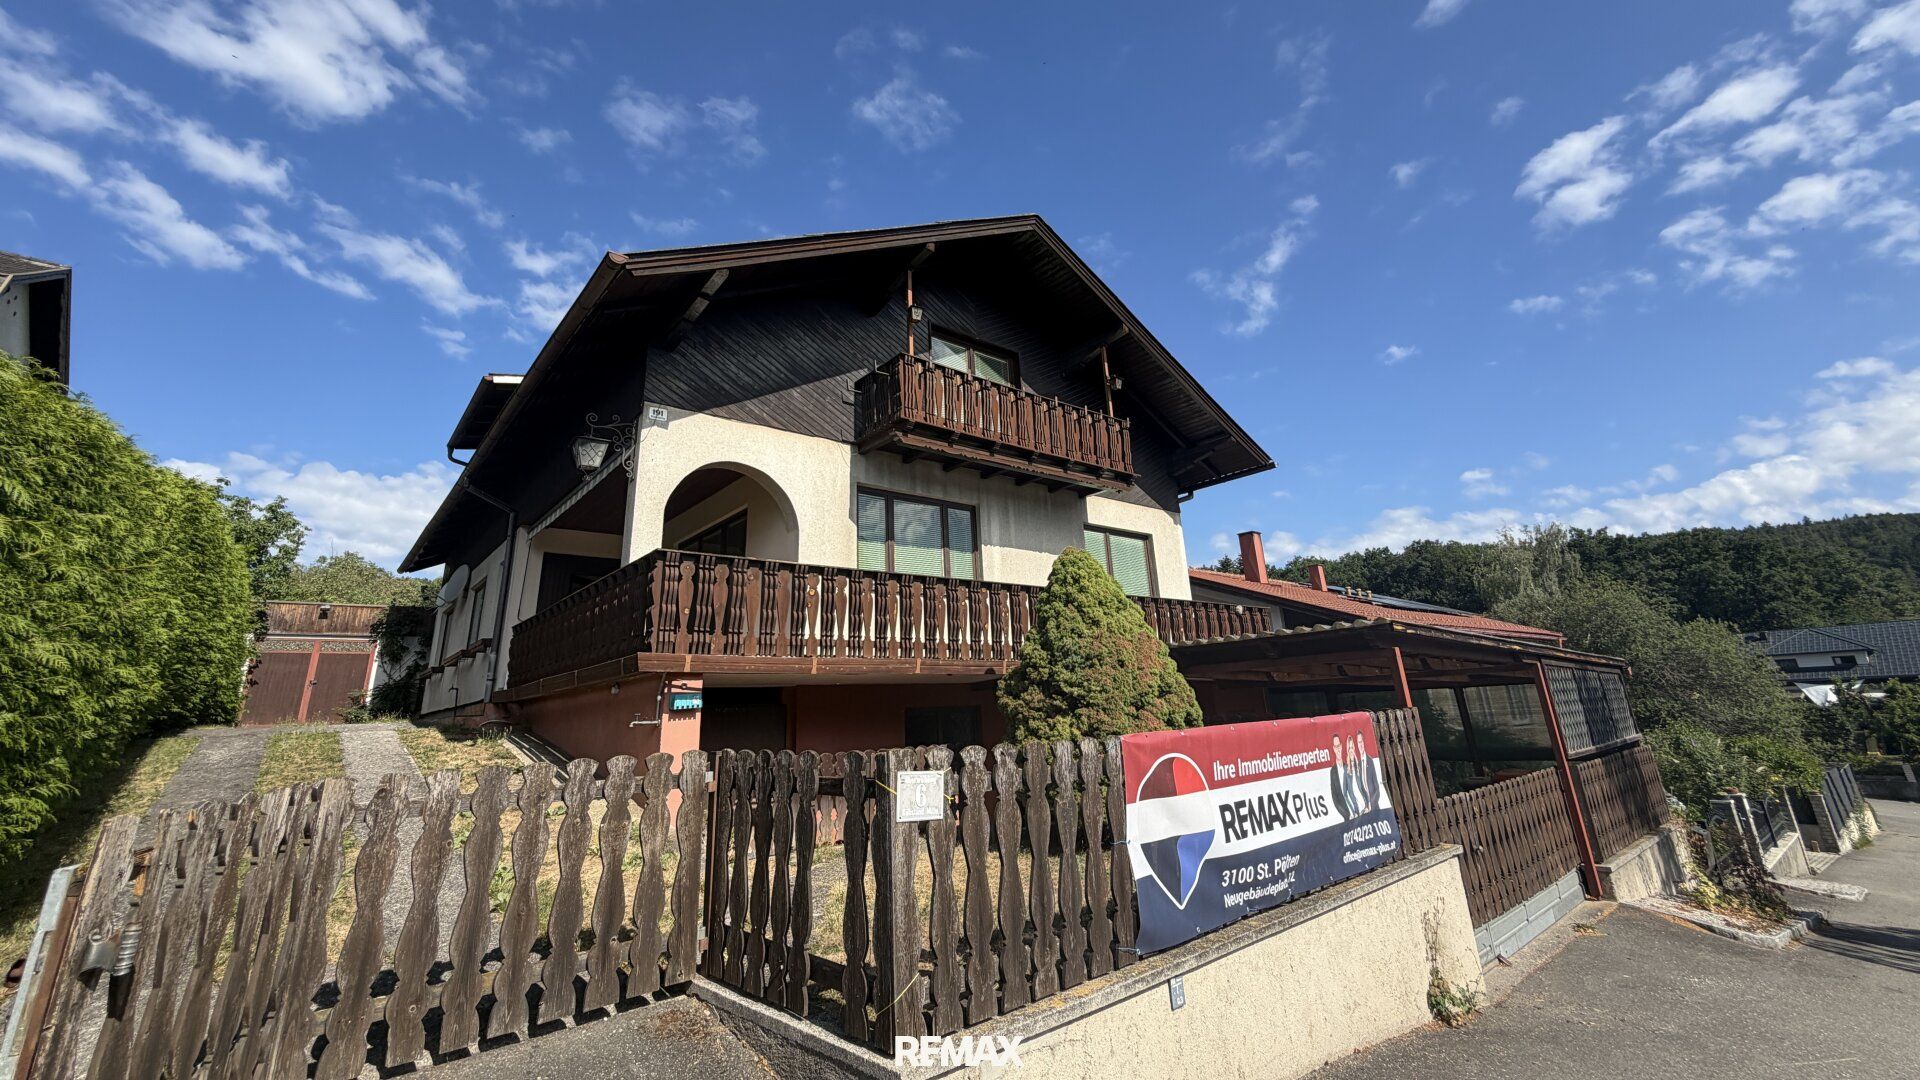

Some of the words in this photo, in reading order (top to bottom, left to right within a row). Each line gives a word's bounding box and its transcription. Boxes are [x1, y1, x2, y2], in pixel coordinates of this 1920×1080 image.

[1213, 759, 1236, 781] Ihre
[1238, 748, 1330, 777] Immobilienexperten
[915, 783, 927, 807] 6
[1373, 820, 1392, 837] 100
[1221, 866, 1254, 887] 3100
[1257, 863, 1272, 880] St.
[1274, 854, 1300, 875] Pölten
